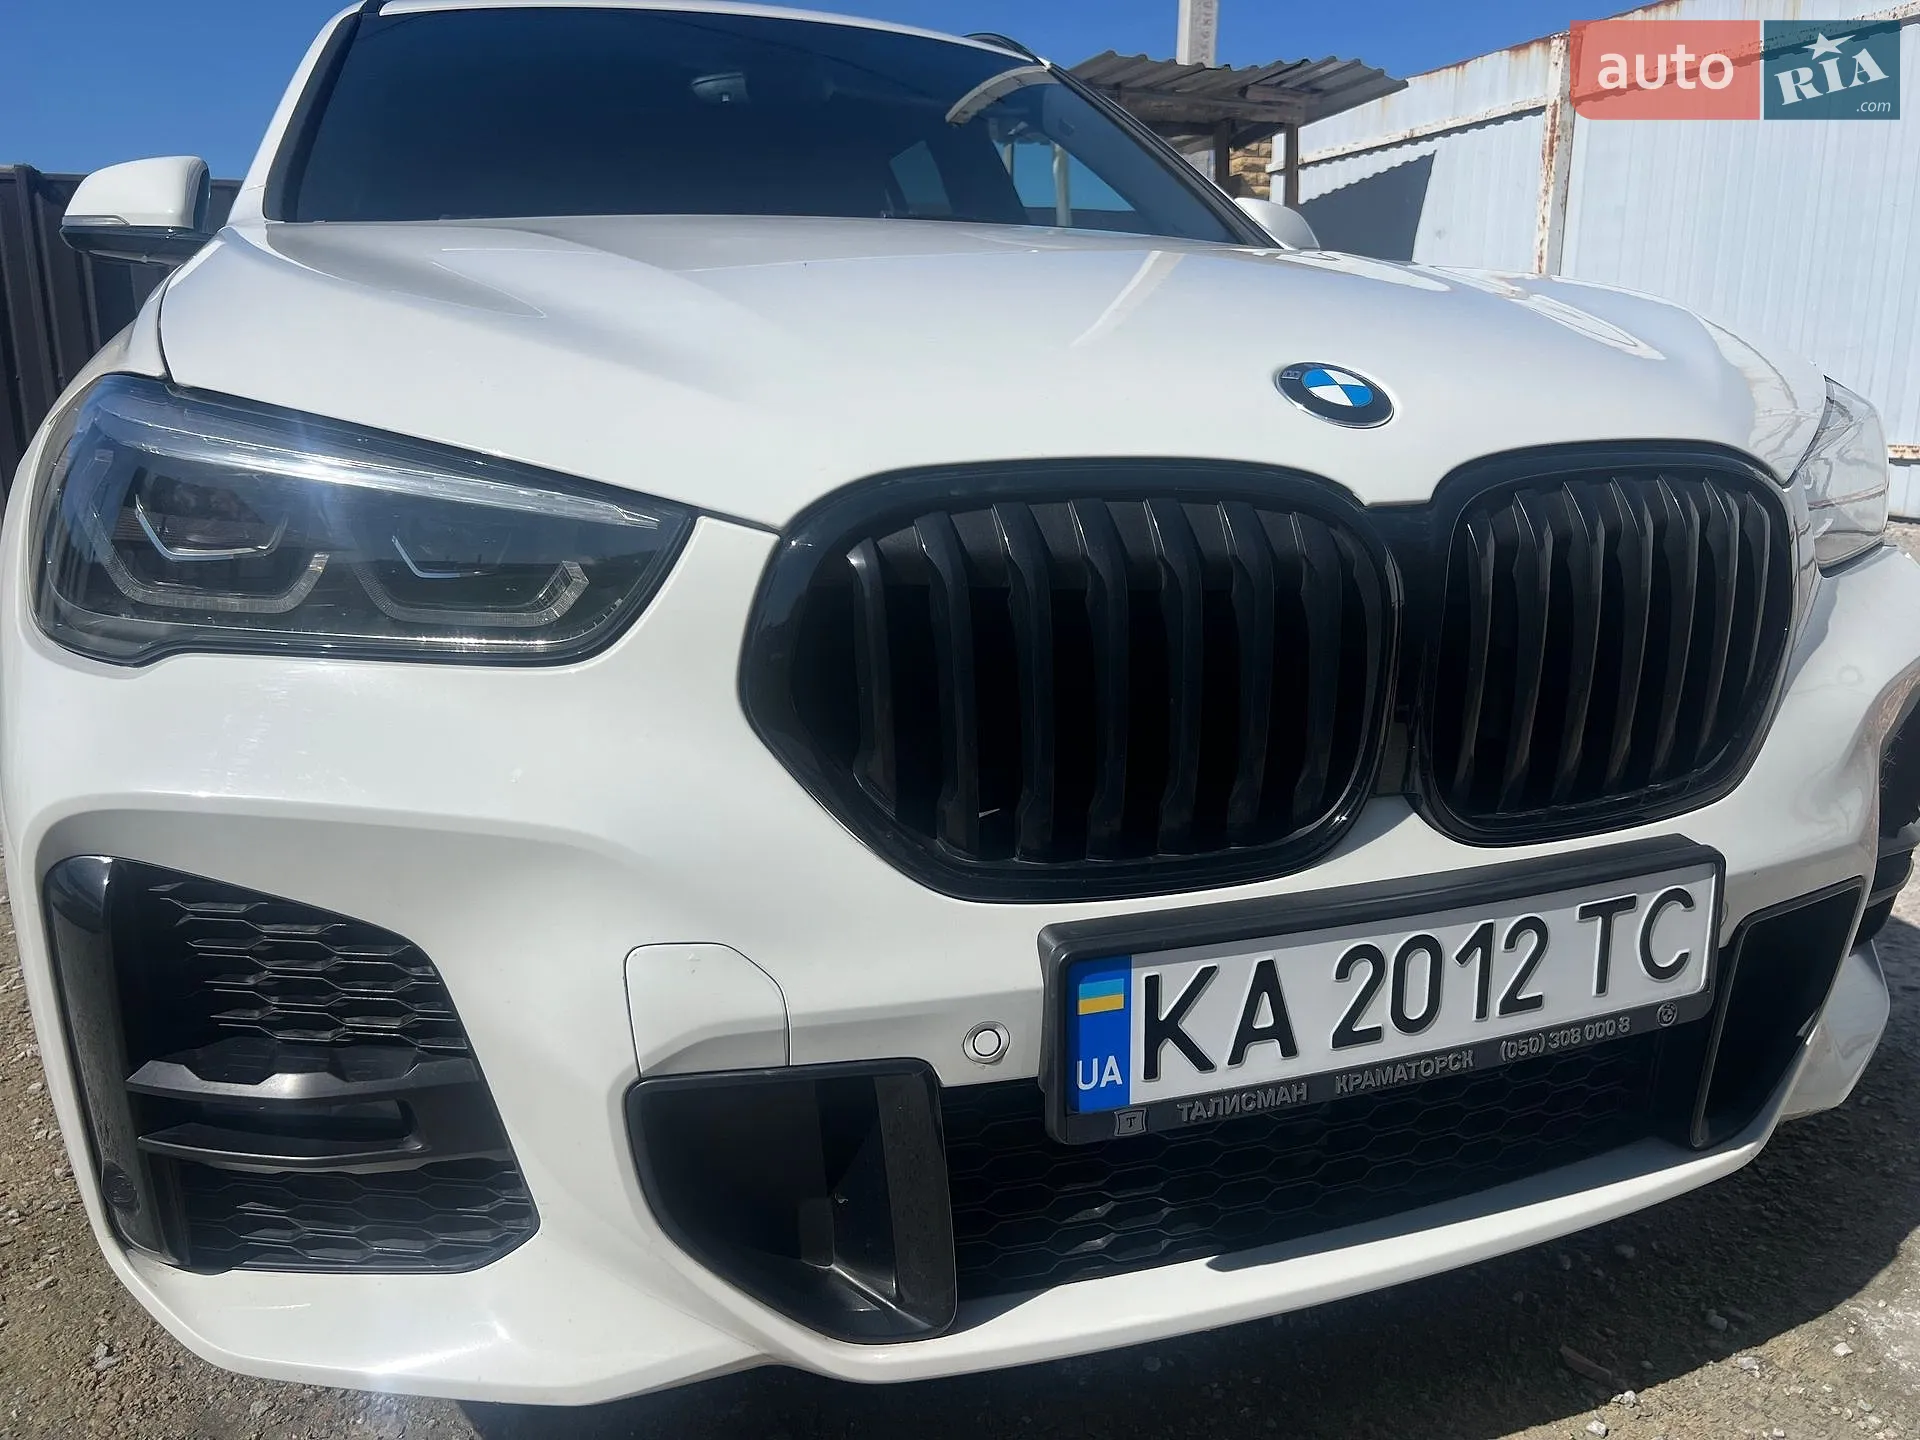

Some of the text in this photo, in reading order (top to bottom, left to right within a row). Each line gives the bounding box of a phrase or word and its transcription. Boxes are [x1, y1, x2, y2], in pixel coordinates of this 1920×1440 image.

[1143, 887, 1695, 1081] KA 2012 TC
[1076, 1055, 1122, 1090] UA
[1177, 1082, 1308, 1122] ТАЛИСМАН
[1335, 1049, 1474, 1094] КРАМАТОРСК
[1500, 1033, 1546, 1062] (050)
[1549, 1027, 1581, 1049] 308
